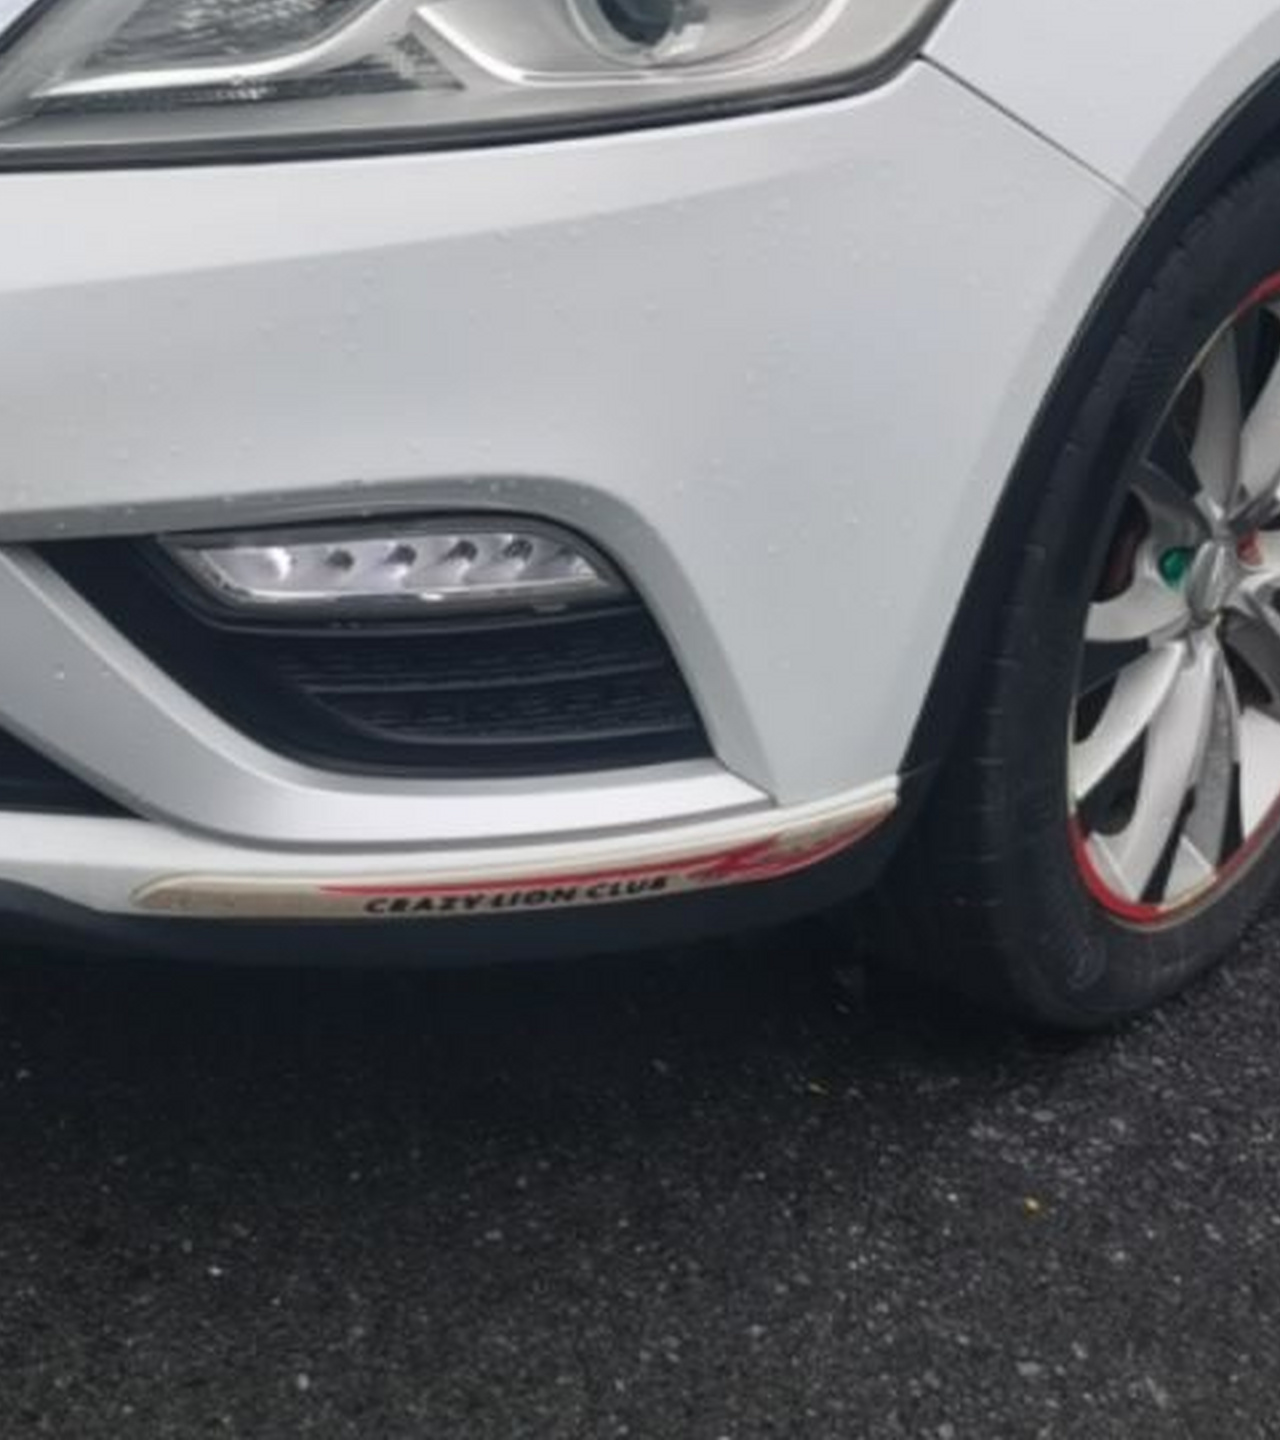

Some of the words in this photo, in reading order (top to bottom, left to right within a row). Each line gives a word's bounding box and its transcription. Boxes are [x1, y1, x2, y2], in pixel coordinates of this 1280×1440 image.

[364, 894, 484, 913] CRAZY
[489, 887, 577, 908] LION
[586, 876, 669, 899] CLUB
